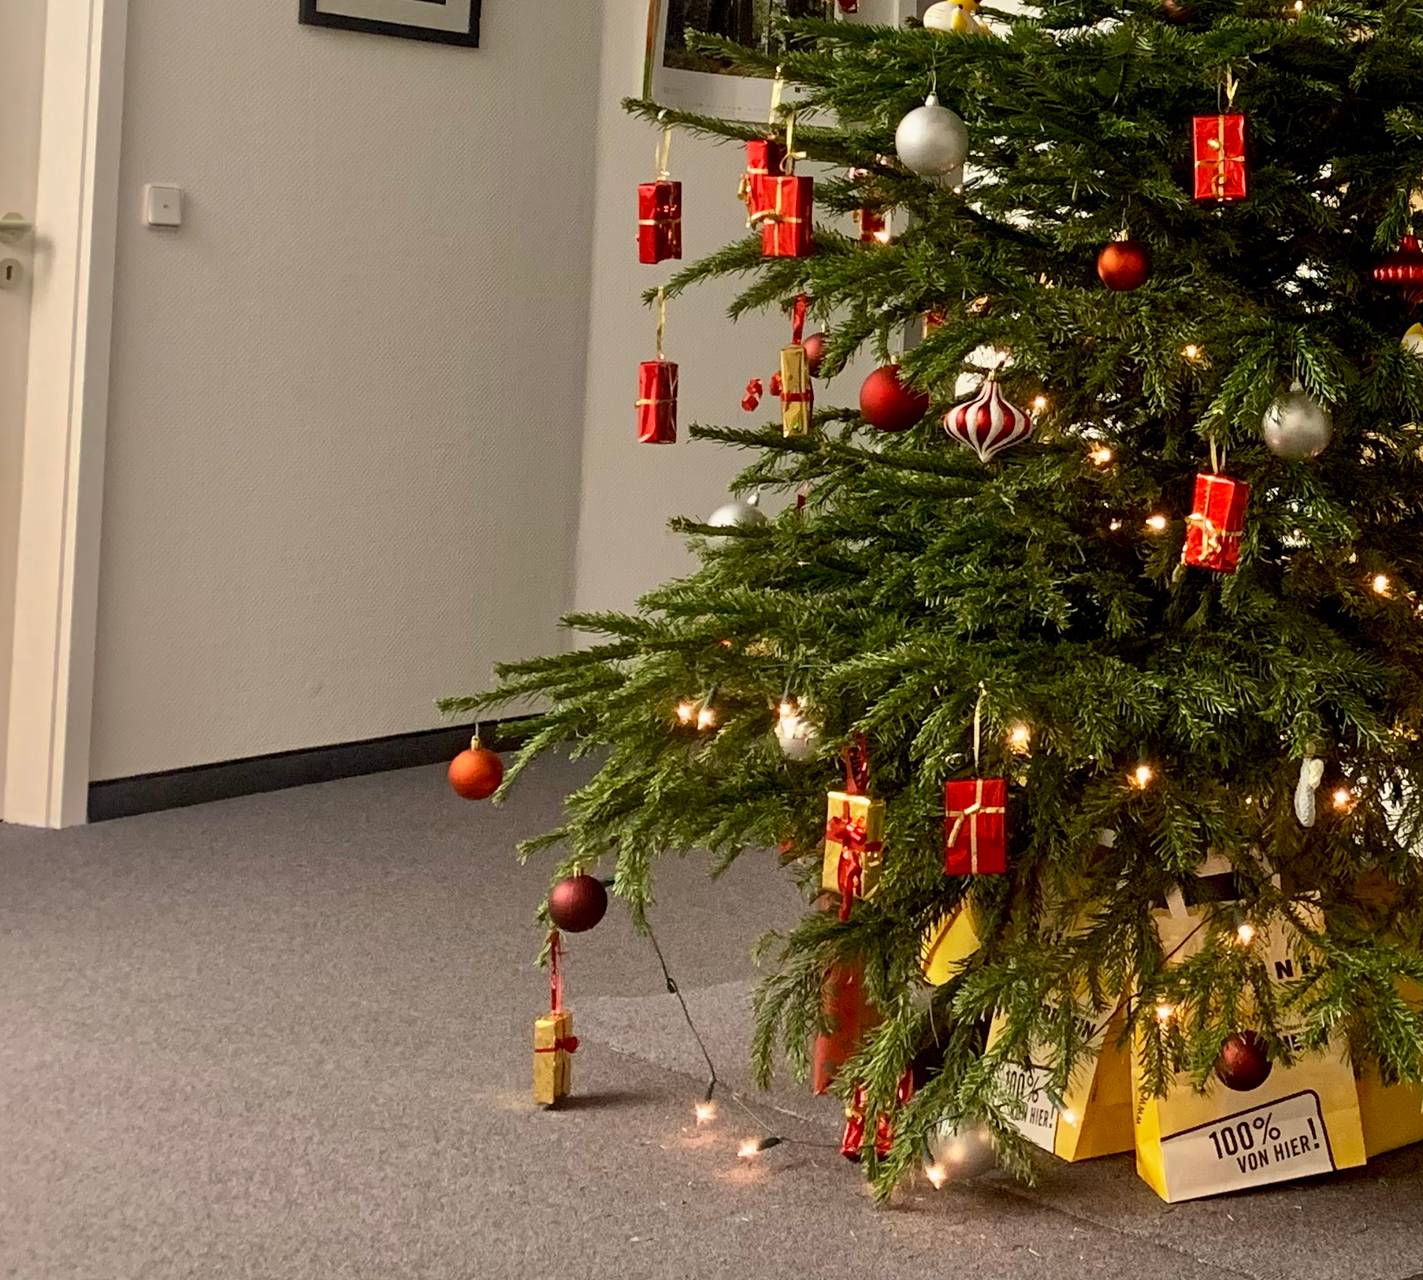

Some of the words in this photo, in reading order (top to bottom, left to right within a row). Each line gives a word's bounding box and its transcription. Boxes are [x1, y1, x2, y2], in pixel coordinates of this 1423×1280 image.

[1029, 1104, 1055, 1129] HIER!
[1208, 1112, 1281, 1160] 100%
[1236, 1148, 1270, 1174] VON
[1273, 1117, 1320, 1163] HIER!
